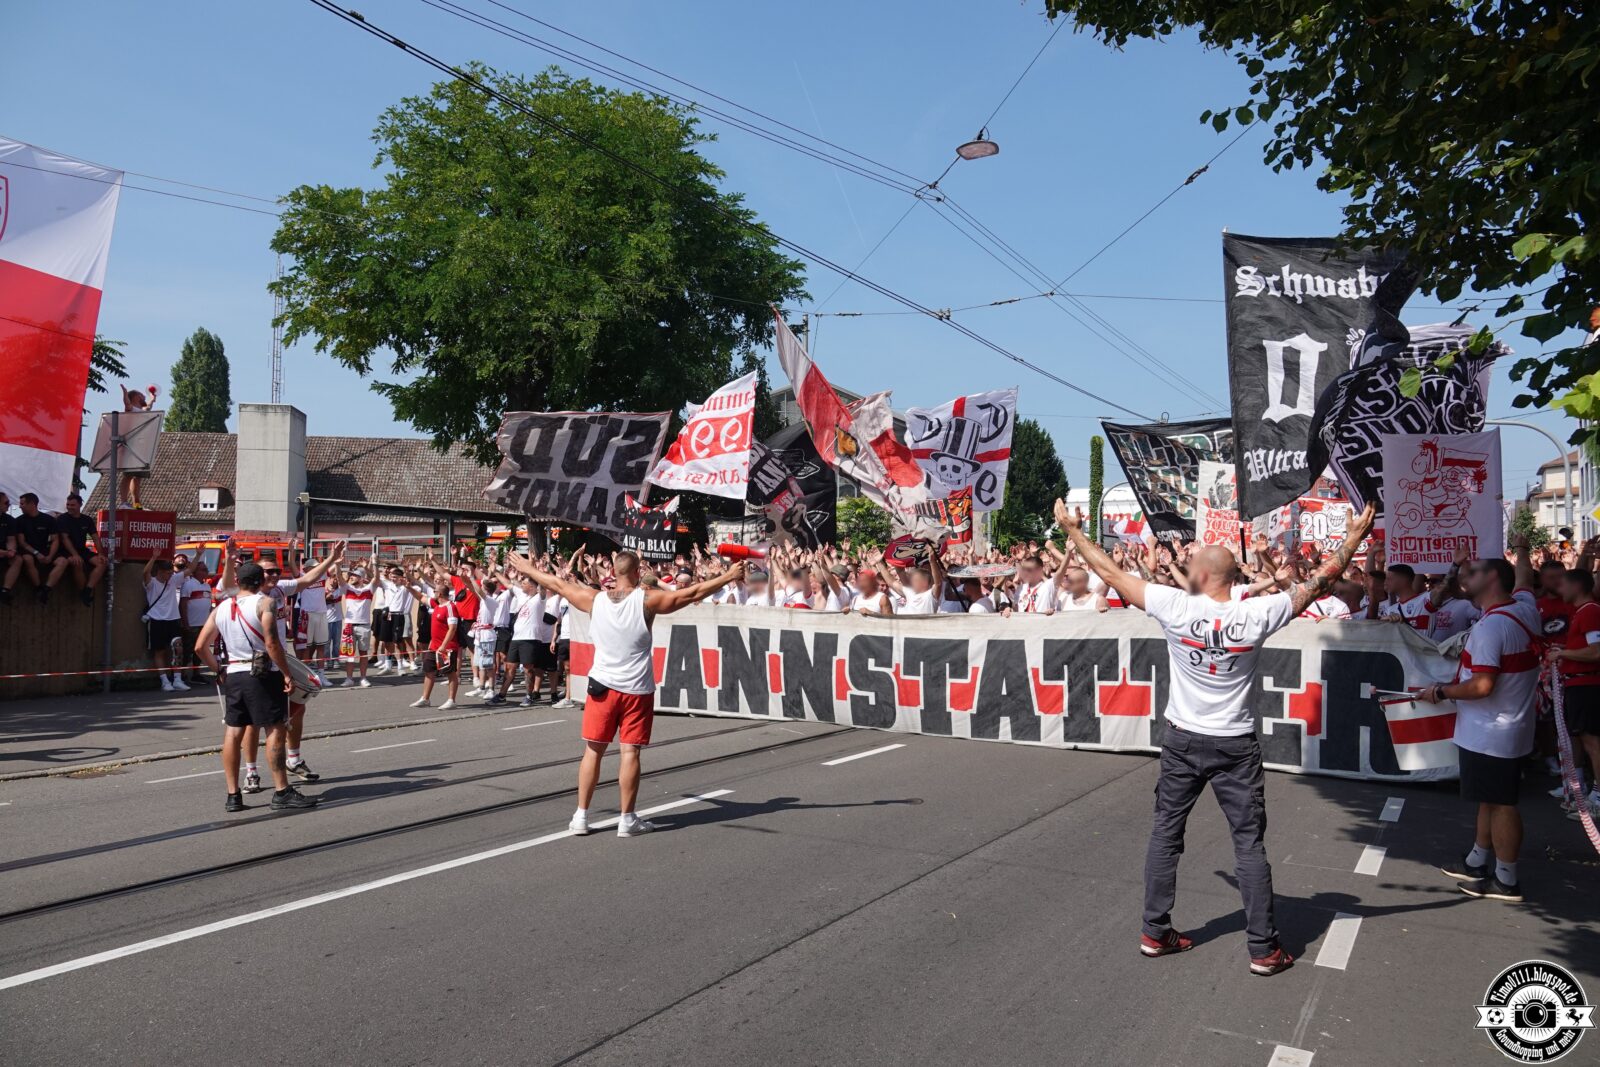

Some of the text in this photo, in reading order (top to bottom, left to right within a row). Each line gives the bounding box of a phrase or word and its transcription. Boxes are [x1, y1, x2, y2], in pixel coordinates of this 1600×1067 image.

[1235, 264, 1390, 303] Schwab
[1244, 447, 1309, 482] Ultra
[129, 521, 172, 533] FEUERWEHR
[130, 537, 169, 549] AUSFAHRT
[659, 625, 1410, 775] ANNSTATTER
